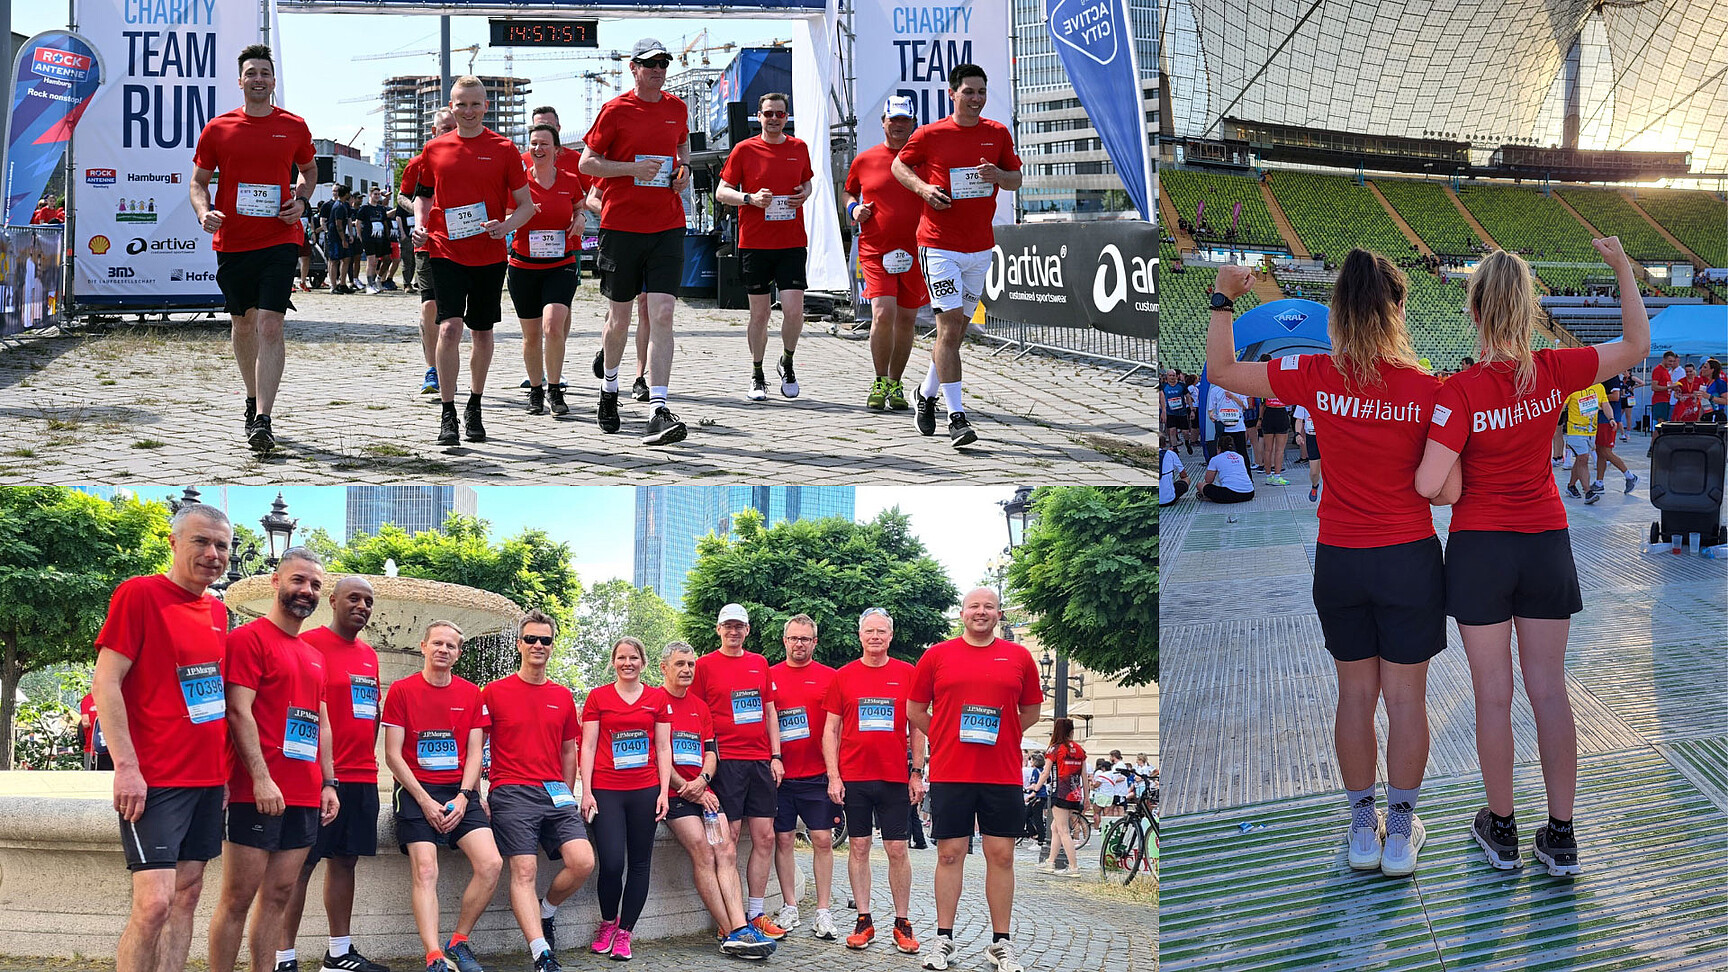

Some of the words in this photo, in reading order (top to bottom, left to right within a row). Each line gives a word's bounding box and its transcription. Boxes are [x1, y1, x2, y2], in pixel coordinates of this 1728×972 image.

[125, 0, 216, 25] CHARITY
[893, 6, 972, 33] CHARITY
[510, 25, 585, 42] 14:57:57
[43, 50, 82, 67] ROCK
[123, 31, 216, 78] TEAM
[35, 63, 86, 79] ANTENNE
[43, 77, 72, 88] Hamburg
[27, 87, 48, 98] Rock
[49, 93, 82, 104] nonstop!
[123, 84, 216, 149] RUN
[965, 172, 979, 180] 376
[253, 189, 268, 198] 376
[457, 210, 473, 220] 376
[1008, 291, 1035, 302] customized
[1035, 292, 1067, 304] sportswear
[1316, 390, 1421, 423] BWI#läuft
[1472, 388, 1563, 433] BWI#läuft
[185, 678, 223, 698] 70396
[733, 698, 761, 709] 70403
[861, 707, 893, 717] 70405
[963, 715, 999, 729] 70404
[289, 721, 318, 740] 7039
[419, 740, 456, 753] 70398
[614, 740, 647, 753] 70401
[674, 740, 701, 751] 70397
